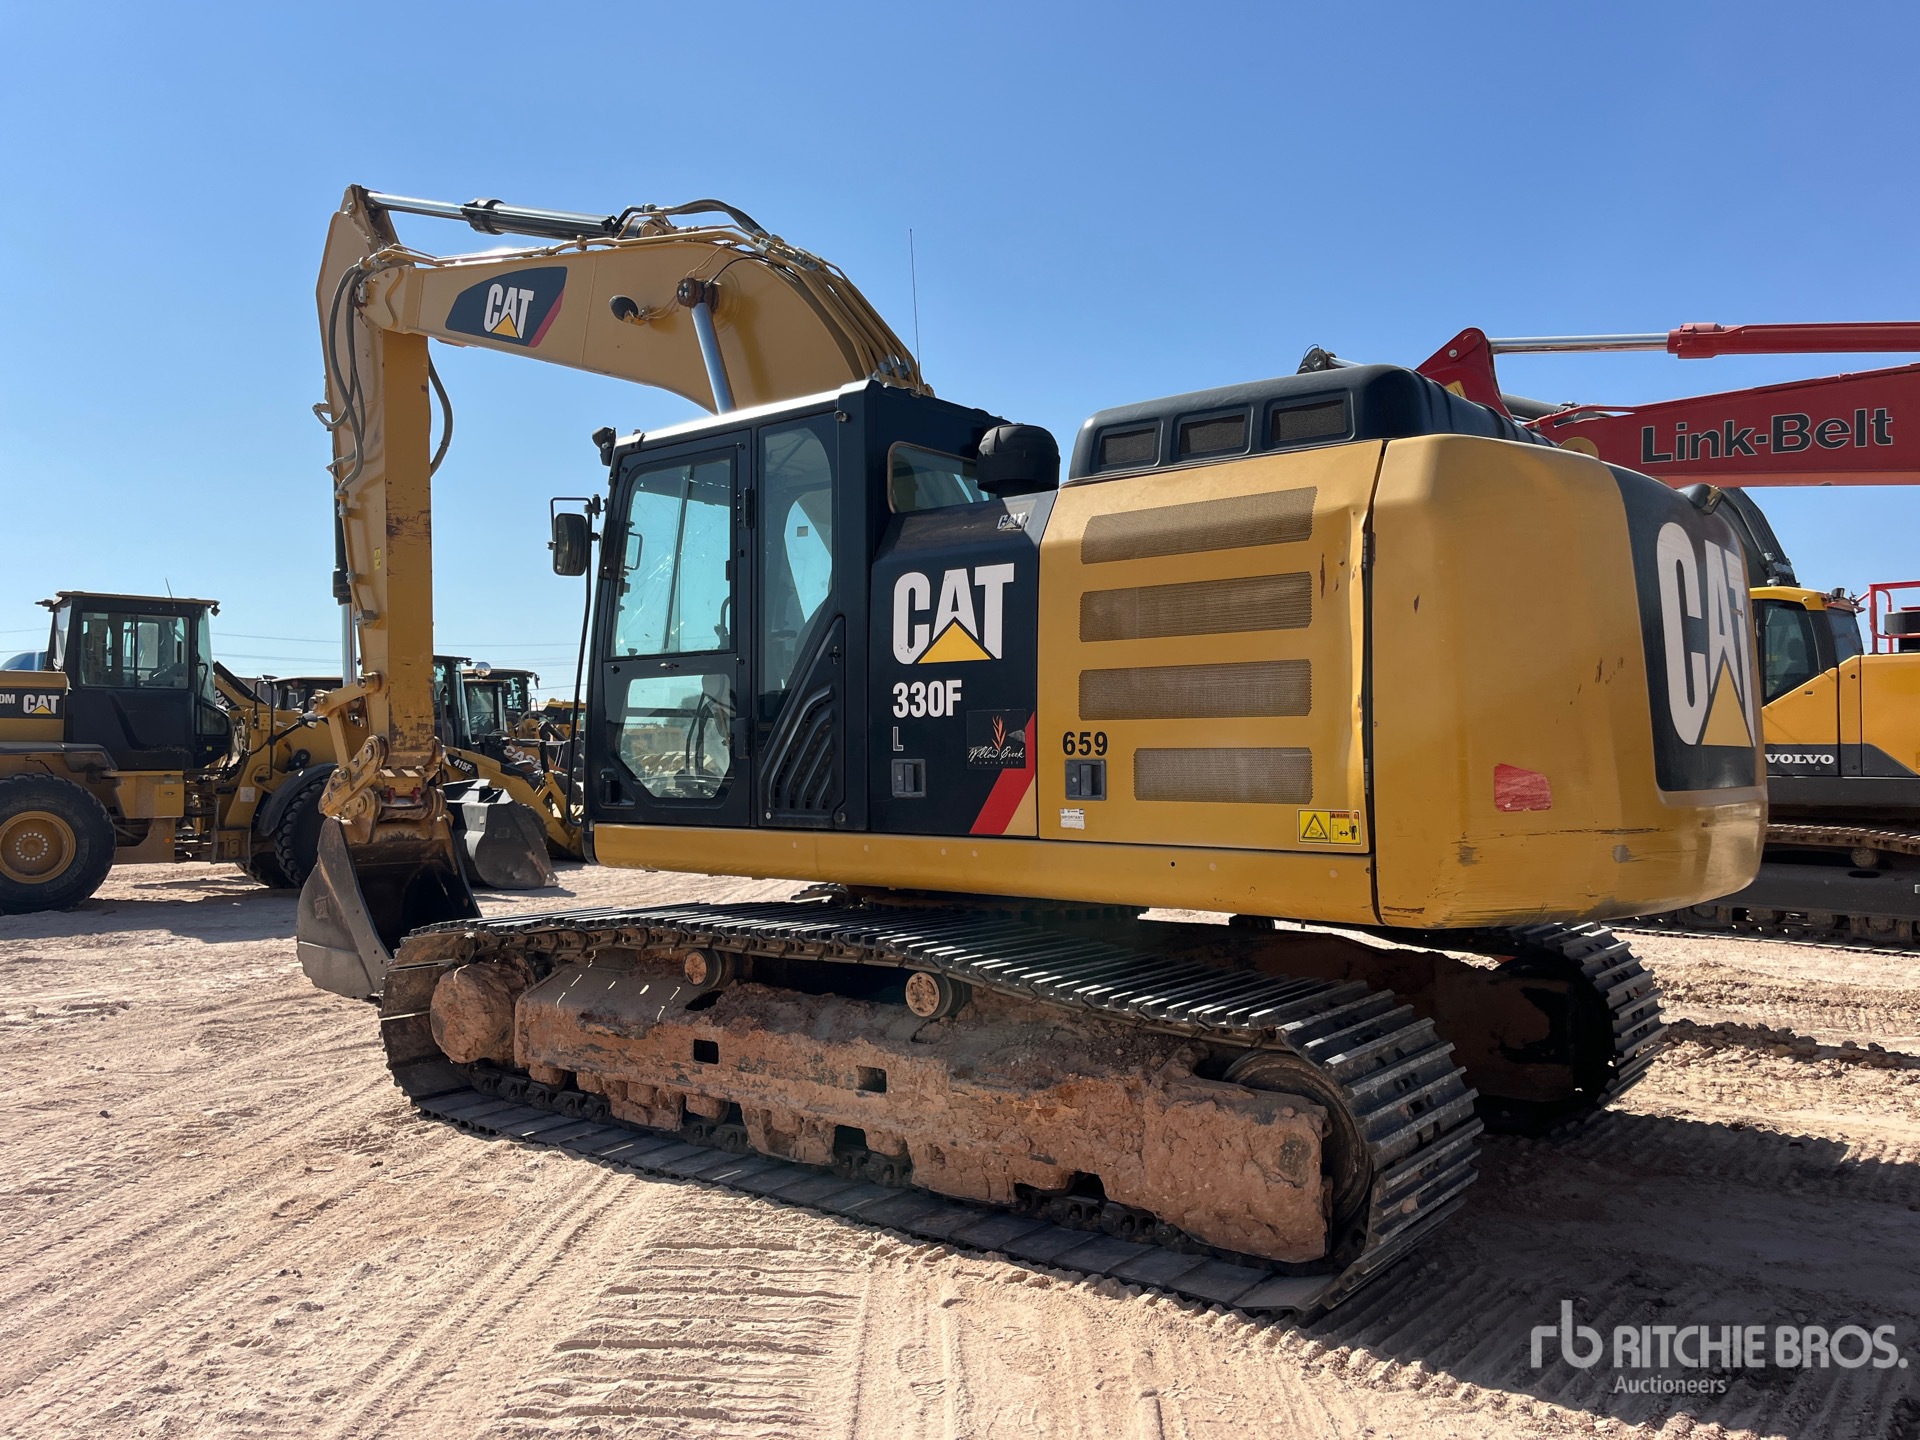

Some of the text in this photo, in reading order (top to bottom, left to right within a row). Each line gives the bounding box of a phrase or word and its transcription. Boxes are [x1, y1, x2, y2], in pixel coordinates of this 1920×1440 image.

[484, 283, 534, 339] CAT
[1641, 408, 1893, 464] Link-Belt
[997, 512, 1026, 530] CAT
[893, 563, 1015, 664] CAT
[1657, 522, 1756, 748] CAT
[23, 694, 60, 714] CAT
[892, 679, 962, 718] 330F
[892, 726, 904, 751] L
[1063, 731, 1108, 756] 659
[1765, 753, 1835, 765] VOLVO
